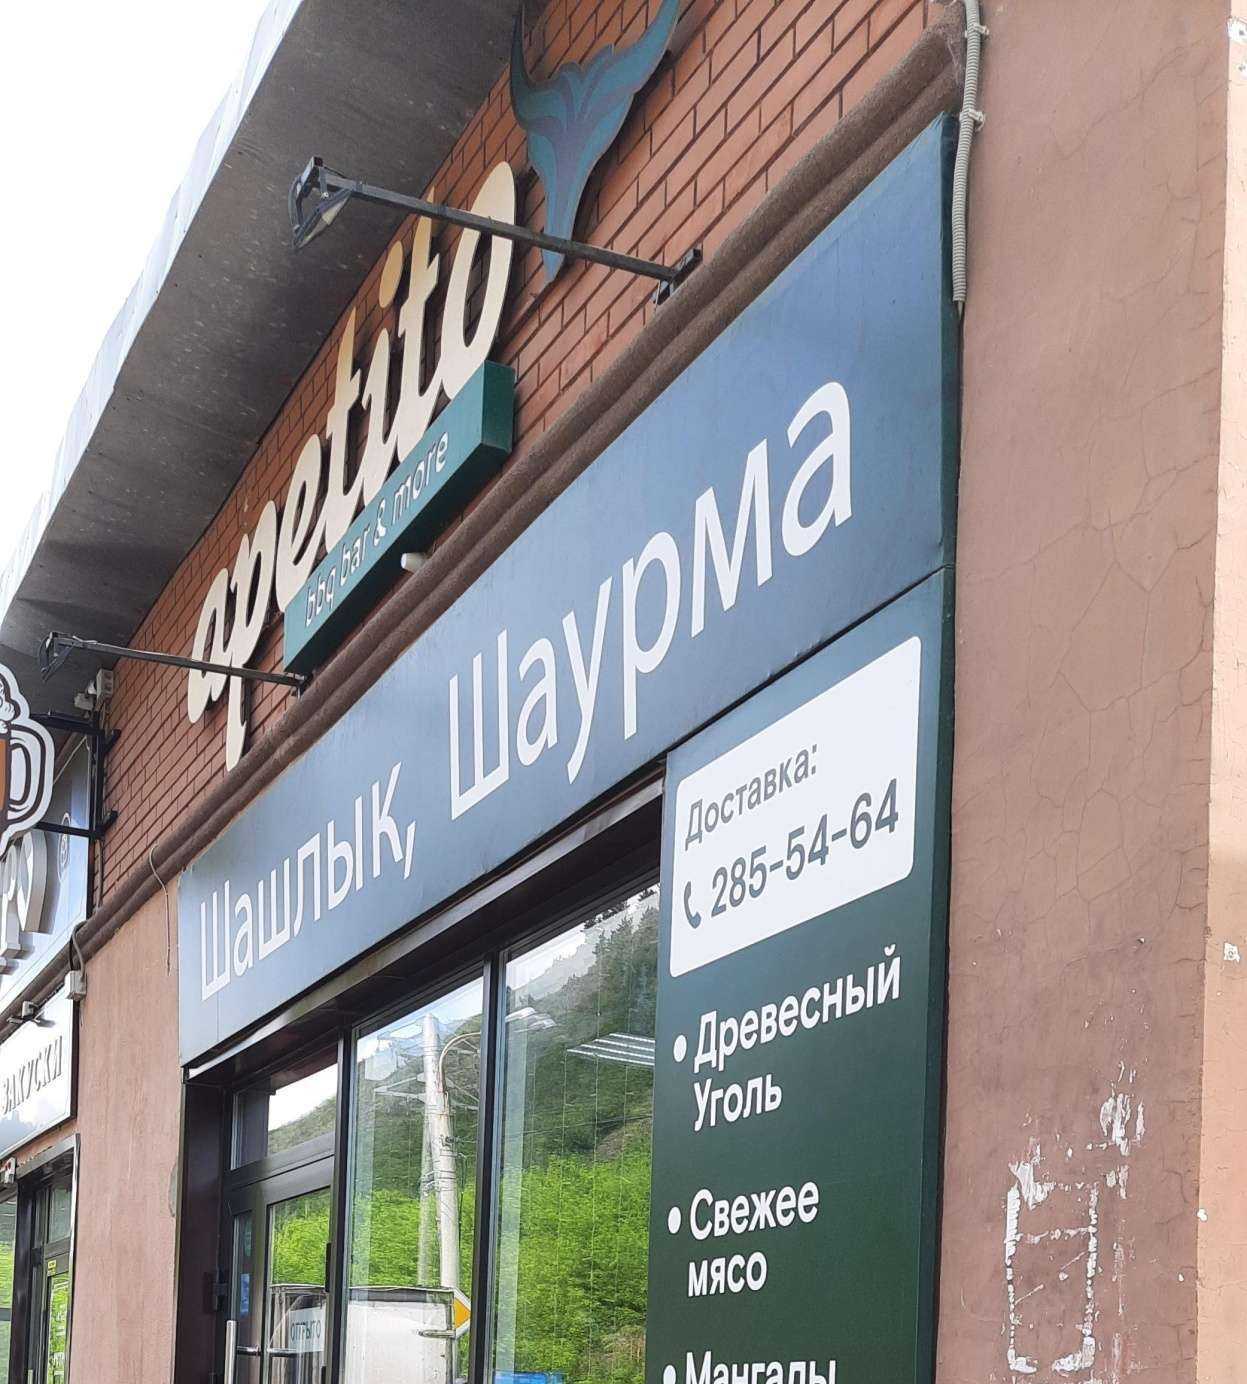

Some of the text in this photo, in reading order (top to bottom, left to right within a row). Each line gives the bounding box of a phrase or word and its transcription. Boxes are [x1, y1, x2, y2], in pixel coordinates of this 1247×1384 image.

[188, 161, 516, 772] apetito
[305, 432, 448, 627] bbq bar & more
[199, 380, 853, 1002] Шашлык, Шаурма
[685, 743, 818, 851] Доставка:
[710, 777, 899, 918] 285-54-64
[694, 943, 901, 1073] Древесный
[3, 1035, 62, 1115] ЗАКУСКИ
[692, 1073, 783, 1133] Уголь
[689, 1181, 820, 1240] Свежее
[688, 1251, 768, 1297] мясо
